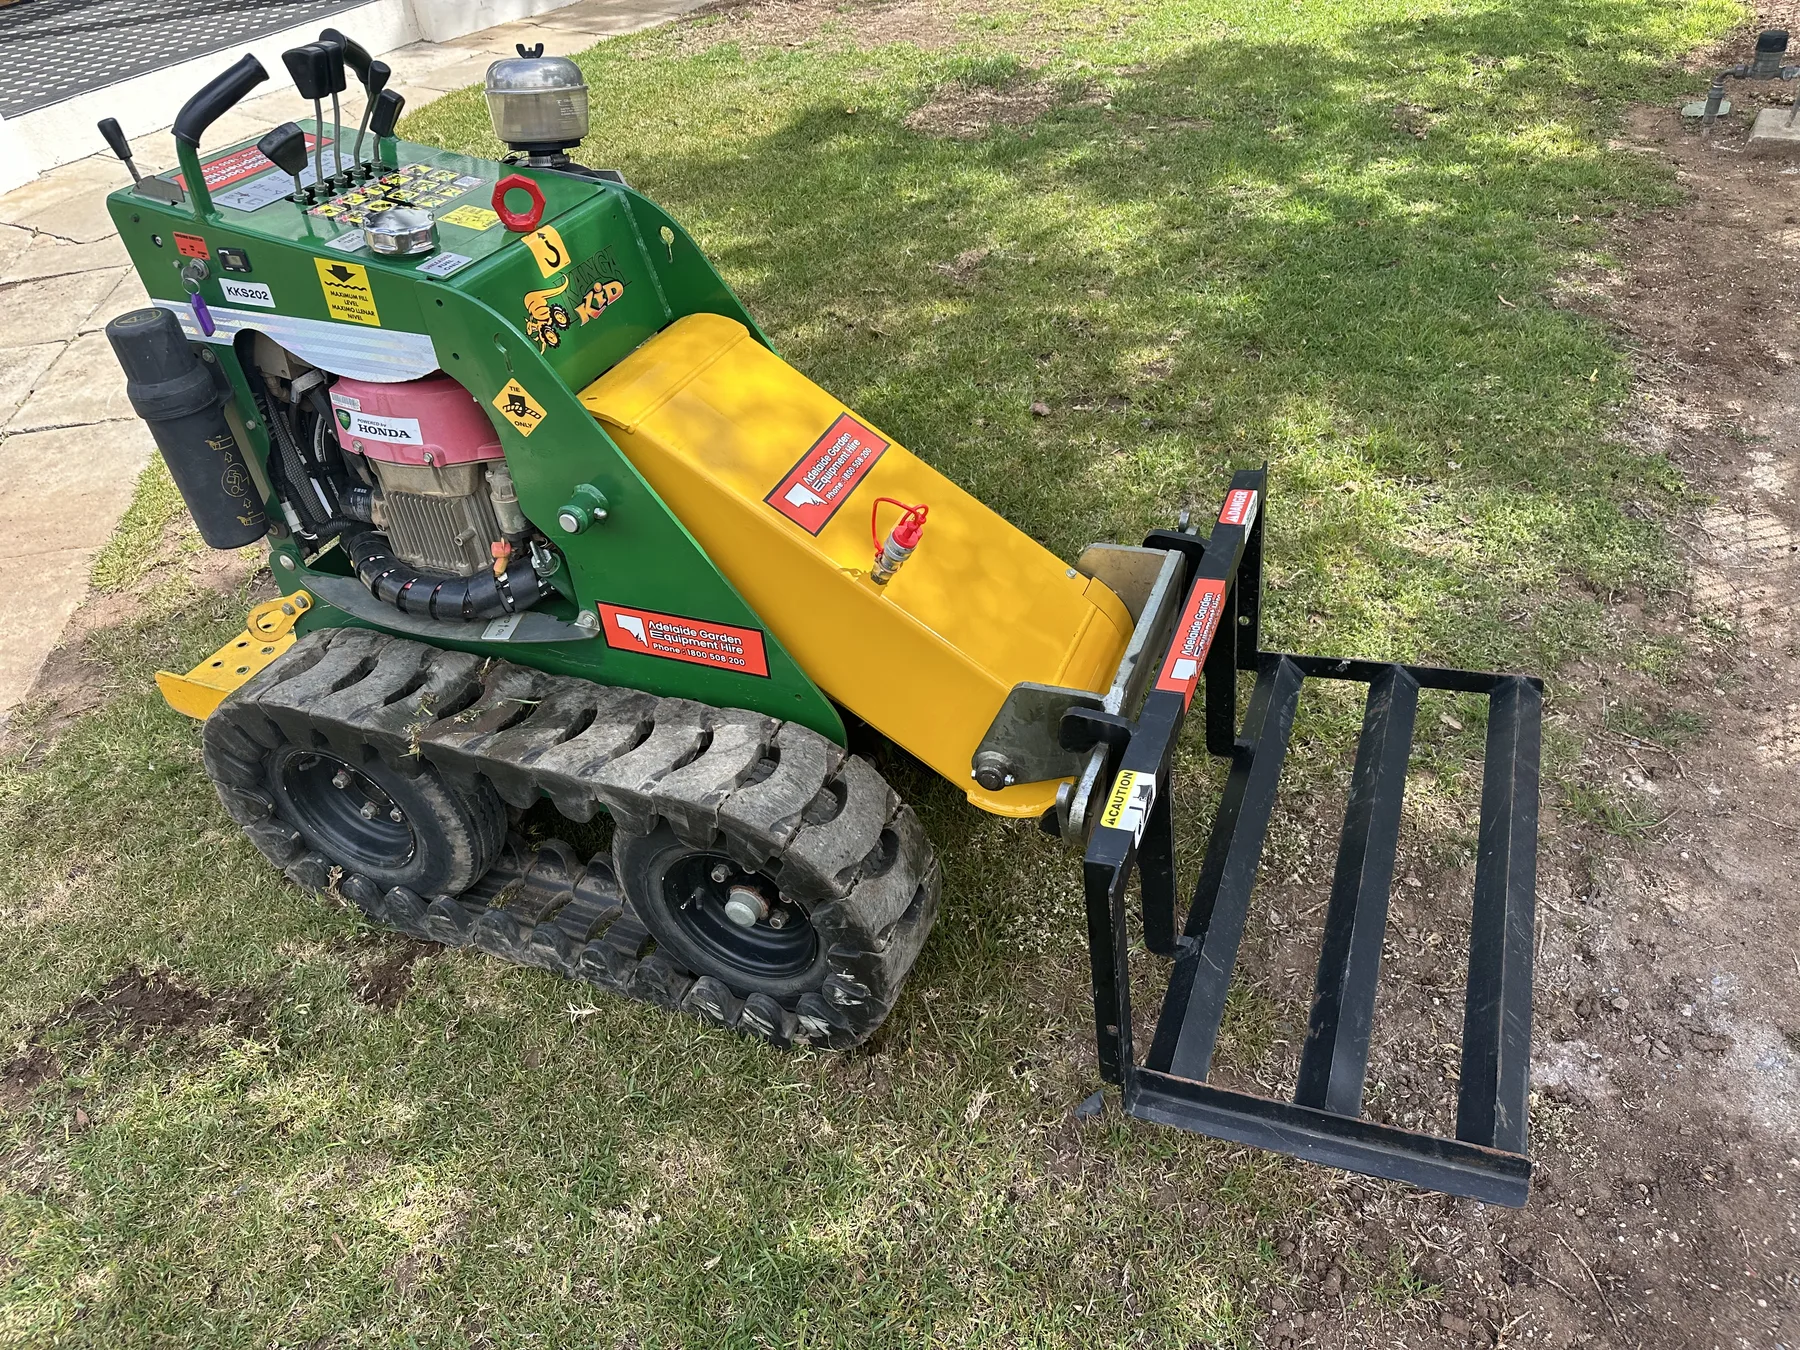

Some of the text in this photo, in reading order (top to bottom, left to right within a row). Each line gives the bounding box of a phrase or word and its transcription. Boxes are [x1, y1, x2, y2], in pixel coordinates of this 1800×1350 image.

[226, 286, 269, 300] KKS202
[330, 291, 358, 300] MAXIMUM
[332, 304, 355, 312] MAXIMO
[358, 424, 412, 438] HONDA
[802, 432, 851, 485] Adelaide Garden
[812, 439, 861, 492] Equipment Hire
[825, 482, 843, 500] Phone
[842, 466, 856, 481] 1800
[852, 456, 864, 468] 508
[860, 447, 872, 459] 200
[1228, 491, 1248, 514] DANGER
[649, 620, 742, 645] Adelaide Garden
[1181, 621, 1202, 656] Adelaide
[1195, 592, 1214, 620] Garden
[650, 631, 743, 655] Equipment Hire
[653, 643, 681, 654] Phone
[687, 649, 707, 659] 1800
[709, 653, 727, 663] 508
[728, 657, 746, 666] 200
[1109, 772, 1133, 817] CAUTION
